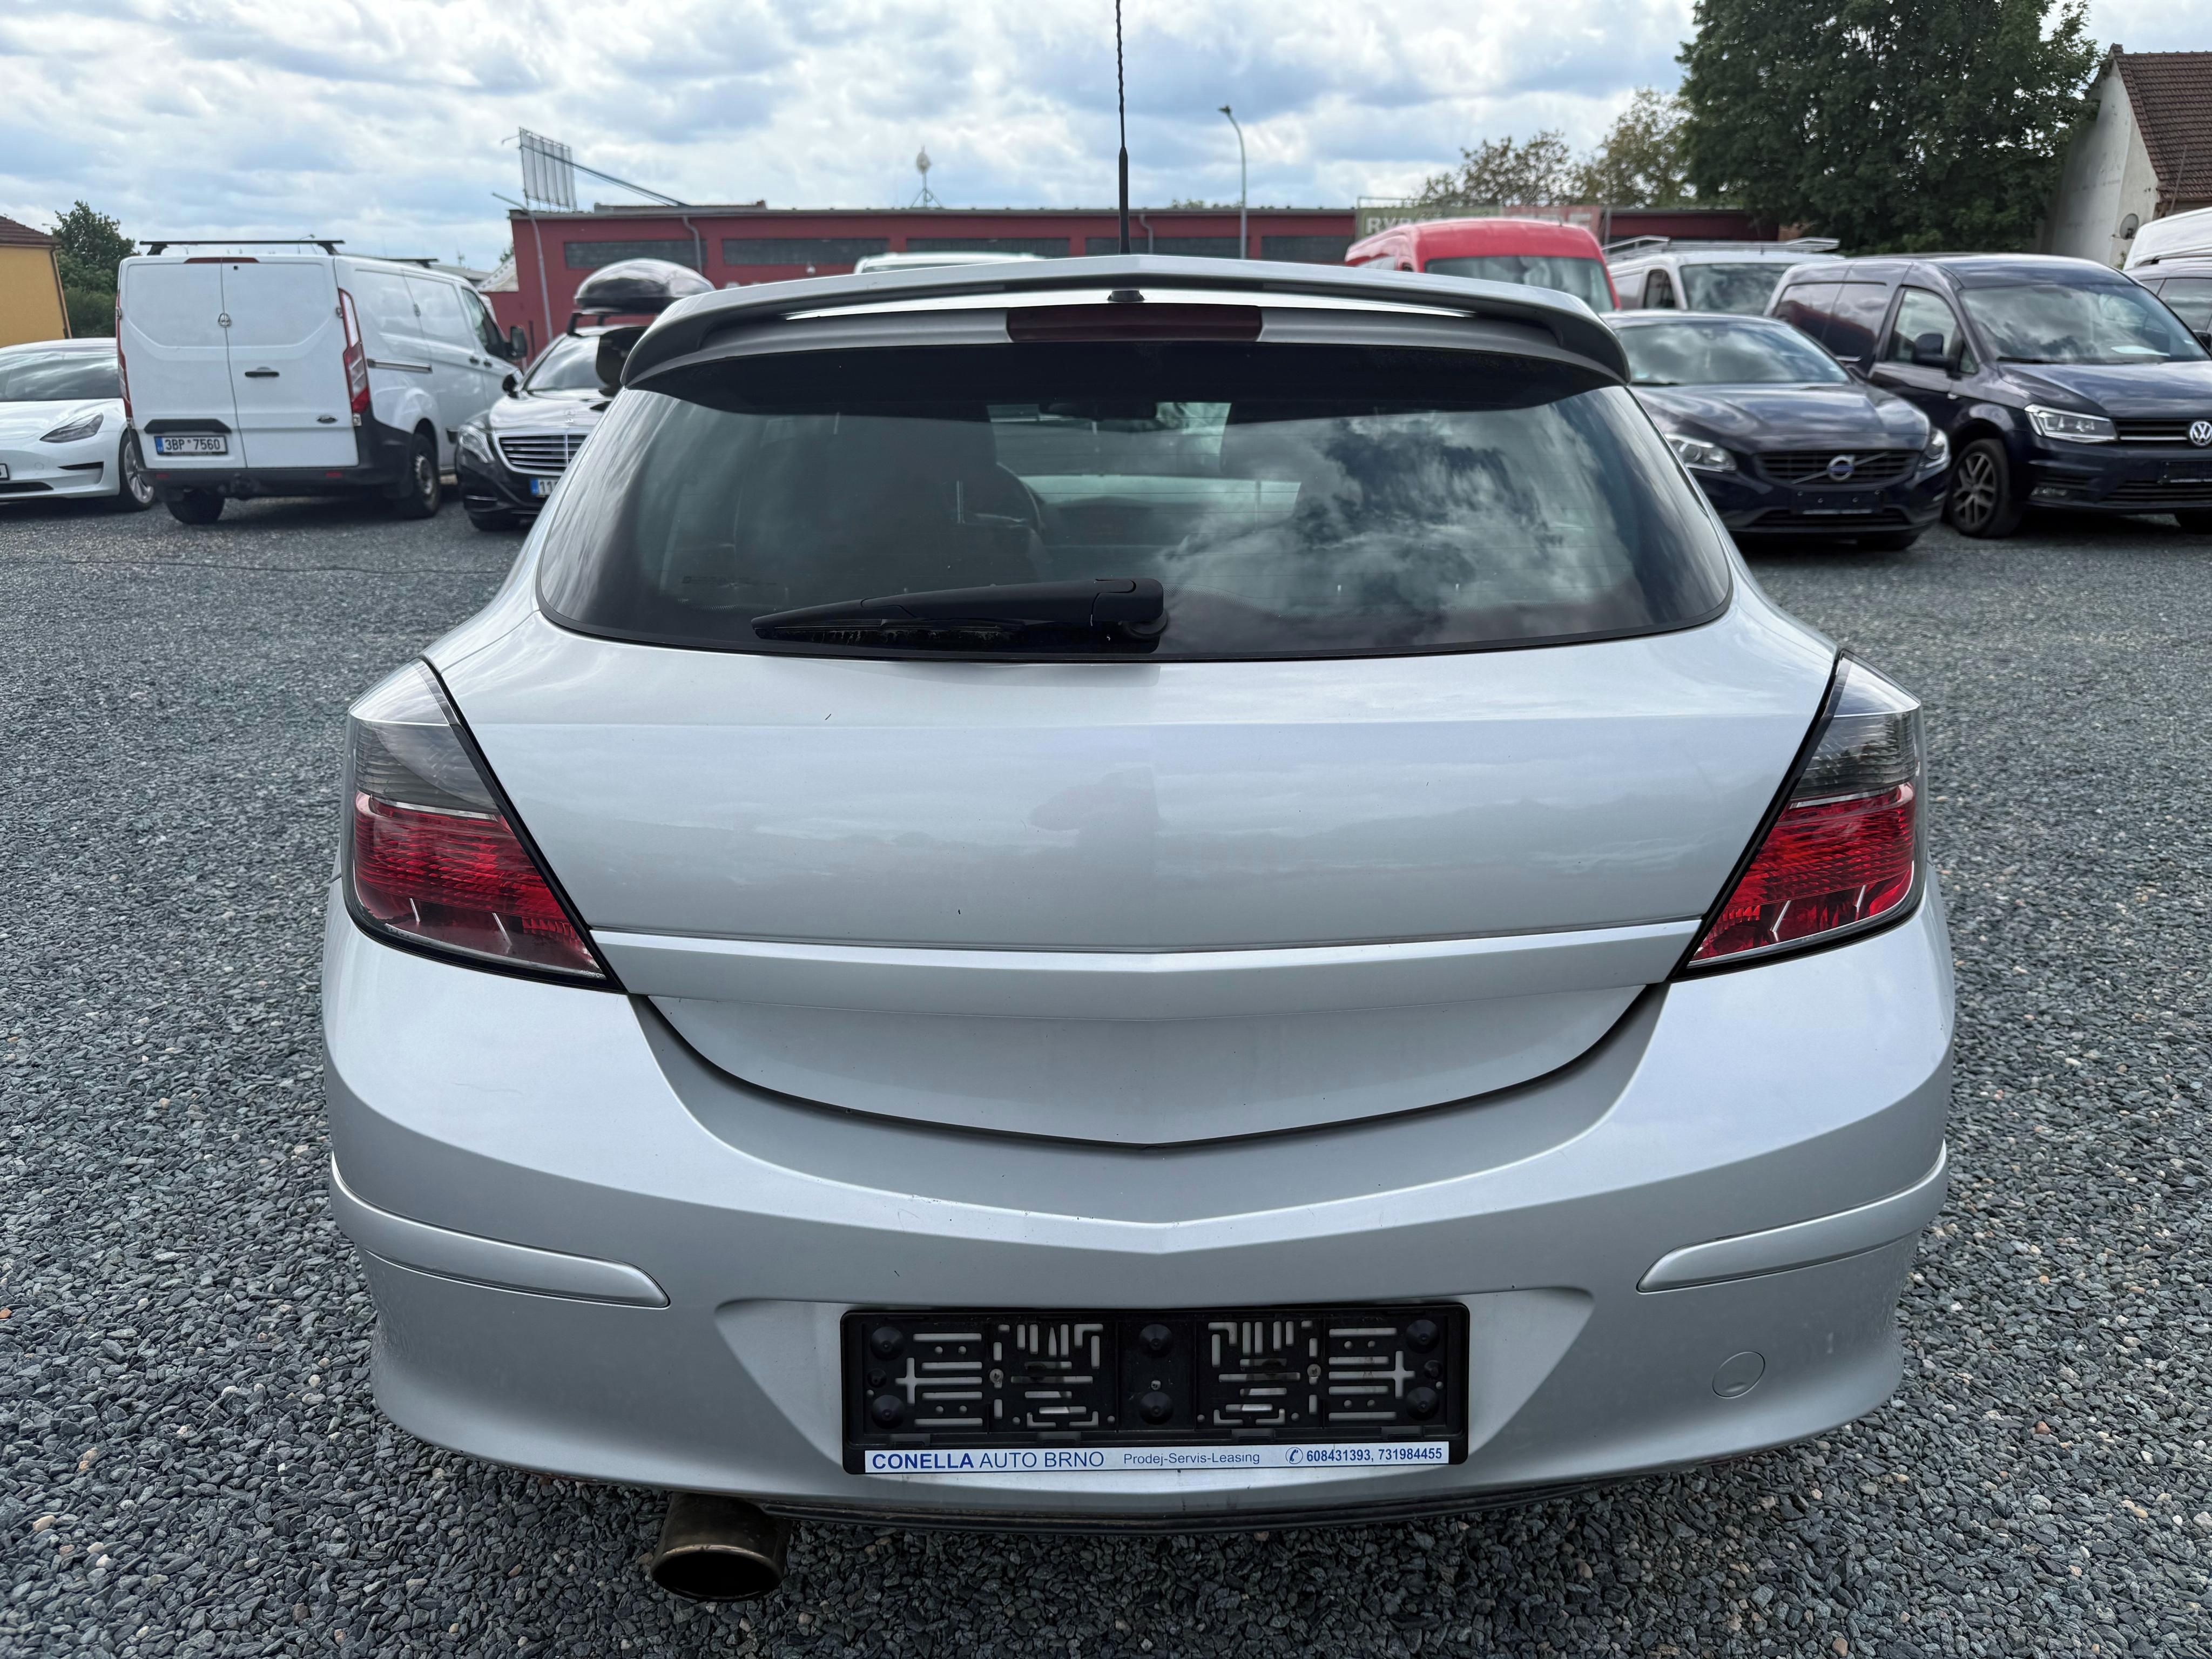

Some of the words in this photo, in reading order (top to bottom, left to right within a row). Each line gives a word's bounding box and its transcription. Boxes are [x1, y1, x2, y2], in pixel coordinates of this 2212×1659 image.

[165, 439, 185, 450] 3BP
[193, 439, 220, 450] 7560
[540, 481, 557, 494] 11
[872, 1453, 974, 1469] CONELLA
[979, 1452, 1037, 1468] AUTO
[1044, 1451, 1104, 1467] BRNO
[1124, 1452, 1260, 1465] Prodej-Servis-Leasing
[1306, 1448, 1374, 1462] 608431393,
[1378, 1447, 1442, 1460] 731984455
